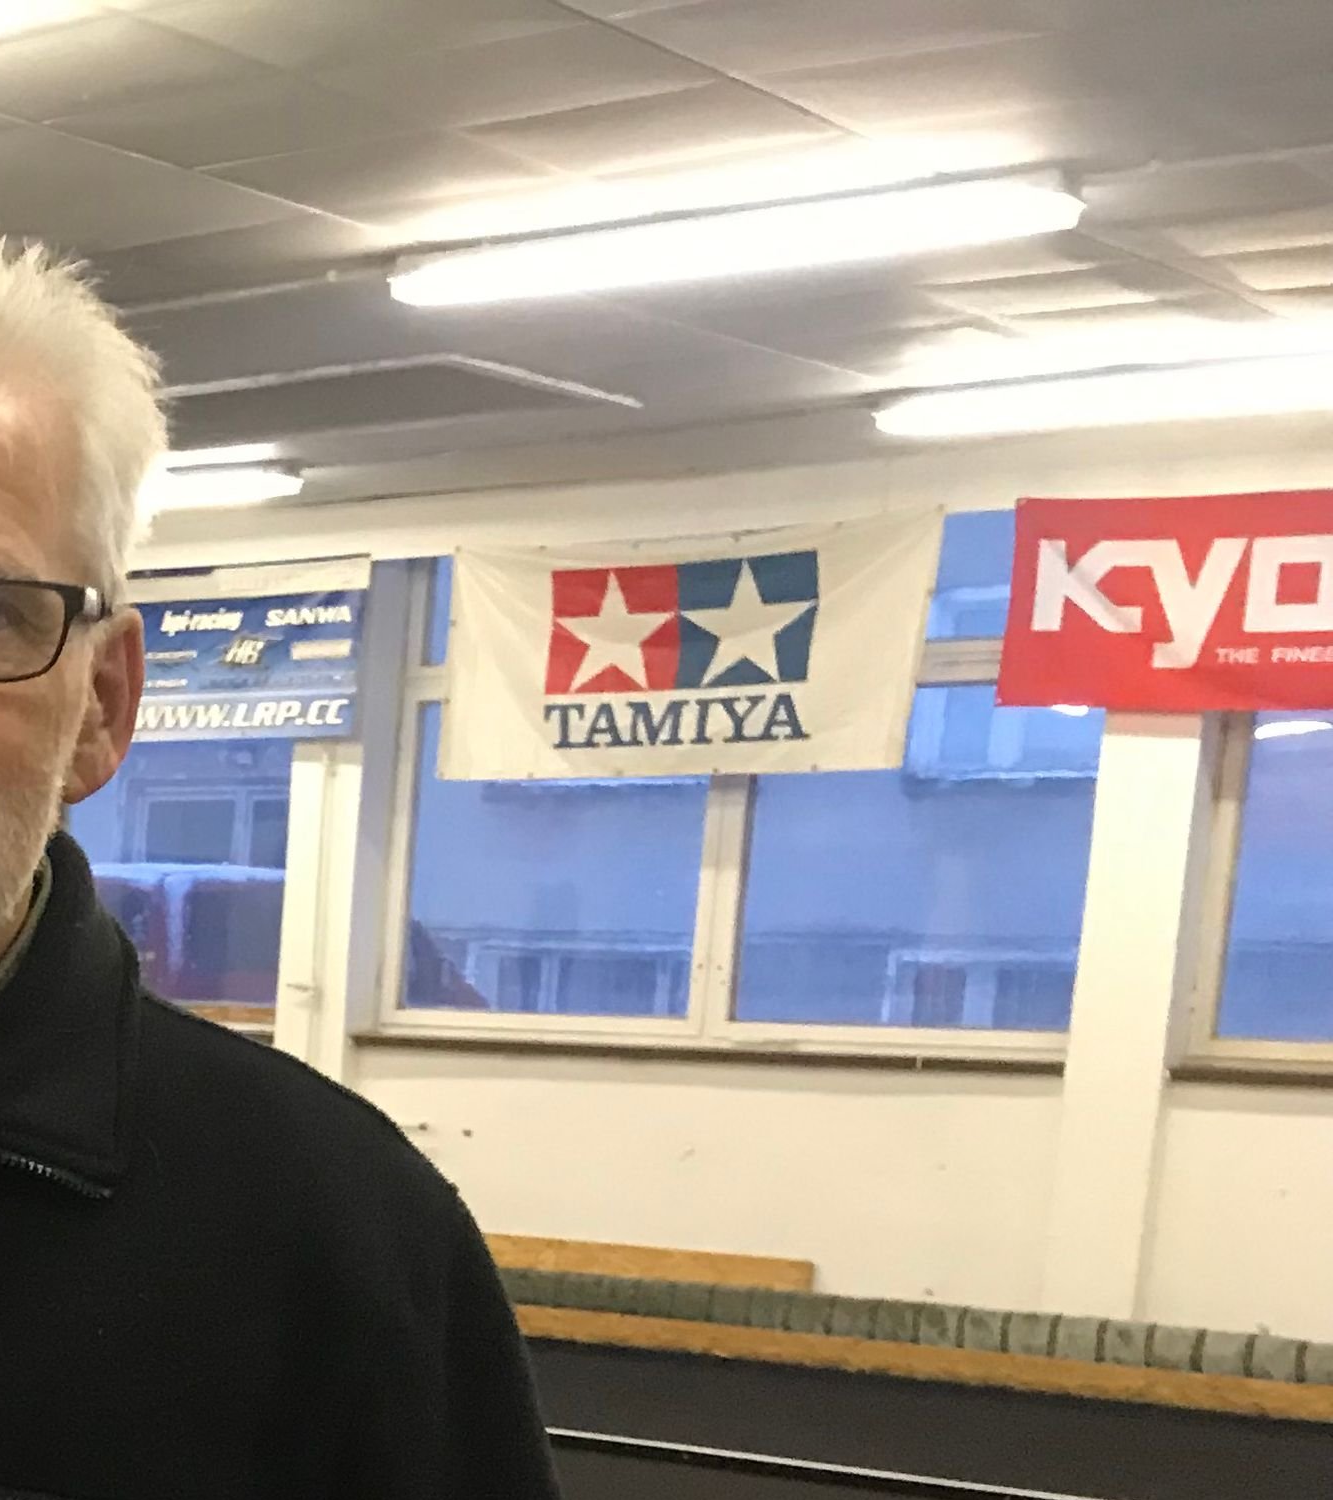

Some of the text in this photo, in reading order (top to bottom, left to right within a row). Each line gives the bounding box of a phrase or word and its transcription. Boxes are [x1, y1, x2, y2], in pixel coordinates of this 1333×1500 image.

[265, 605, 352, 628] SANWA
[1215, 646, 1260, 664] THE
[135, 699, 350, 729] WWW.LRP.CC
[544, 692, 811, 750] TAMIYA
